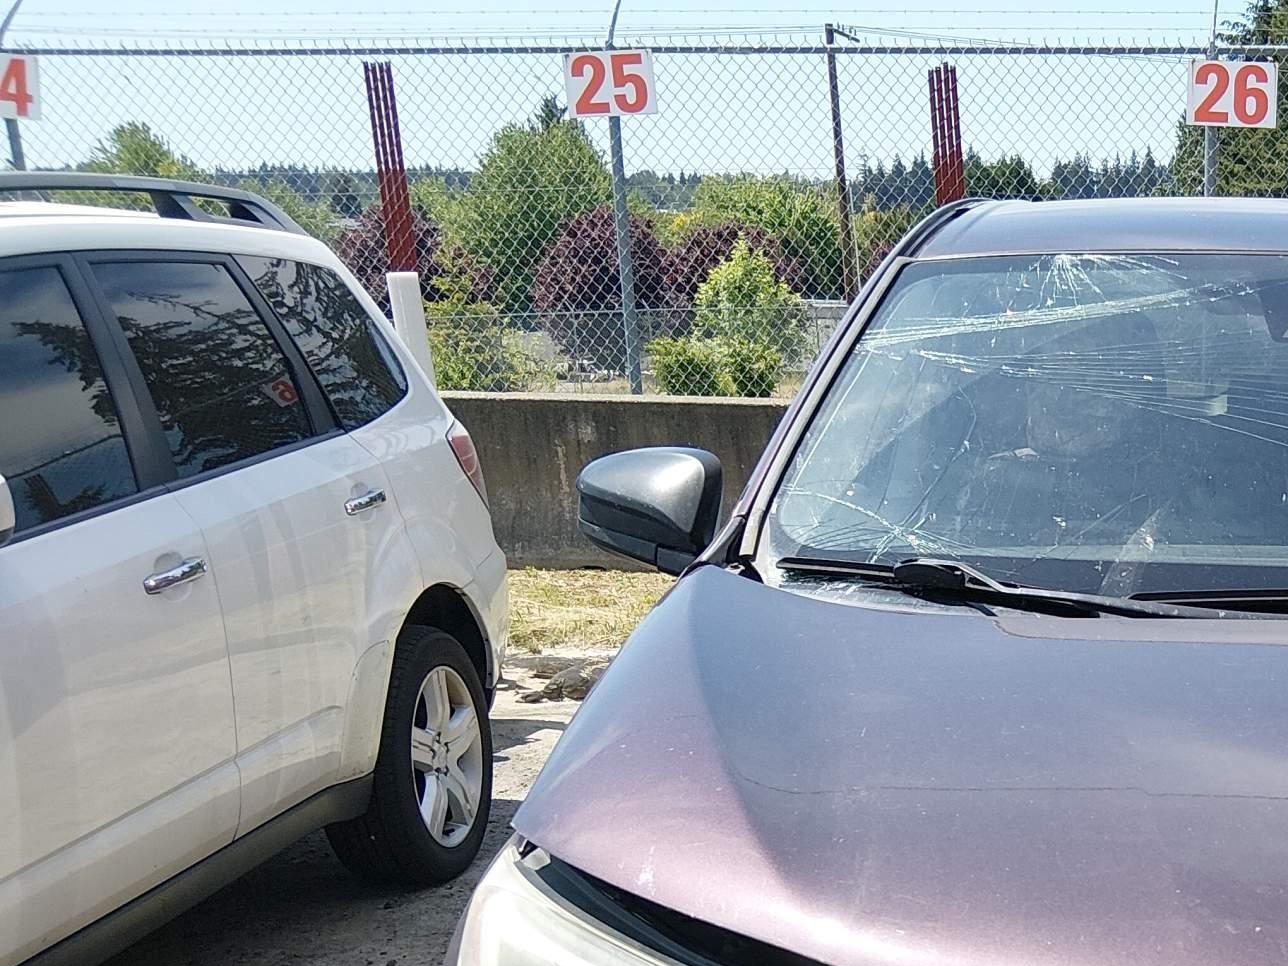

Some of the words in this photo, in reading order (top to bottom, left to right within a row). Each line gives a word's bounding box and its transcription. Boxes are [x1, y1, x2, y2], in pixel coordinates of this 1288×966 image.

[0, 58, 33, 117] 4
[571, 52, 648, 114] 25
[1193, 62, 1270, 125] 26
